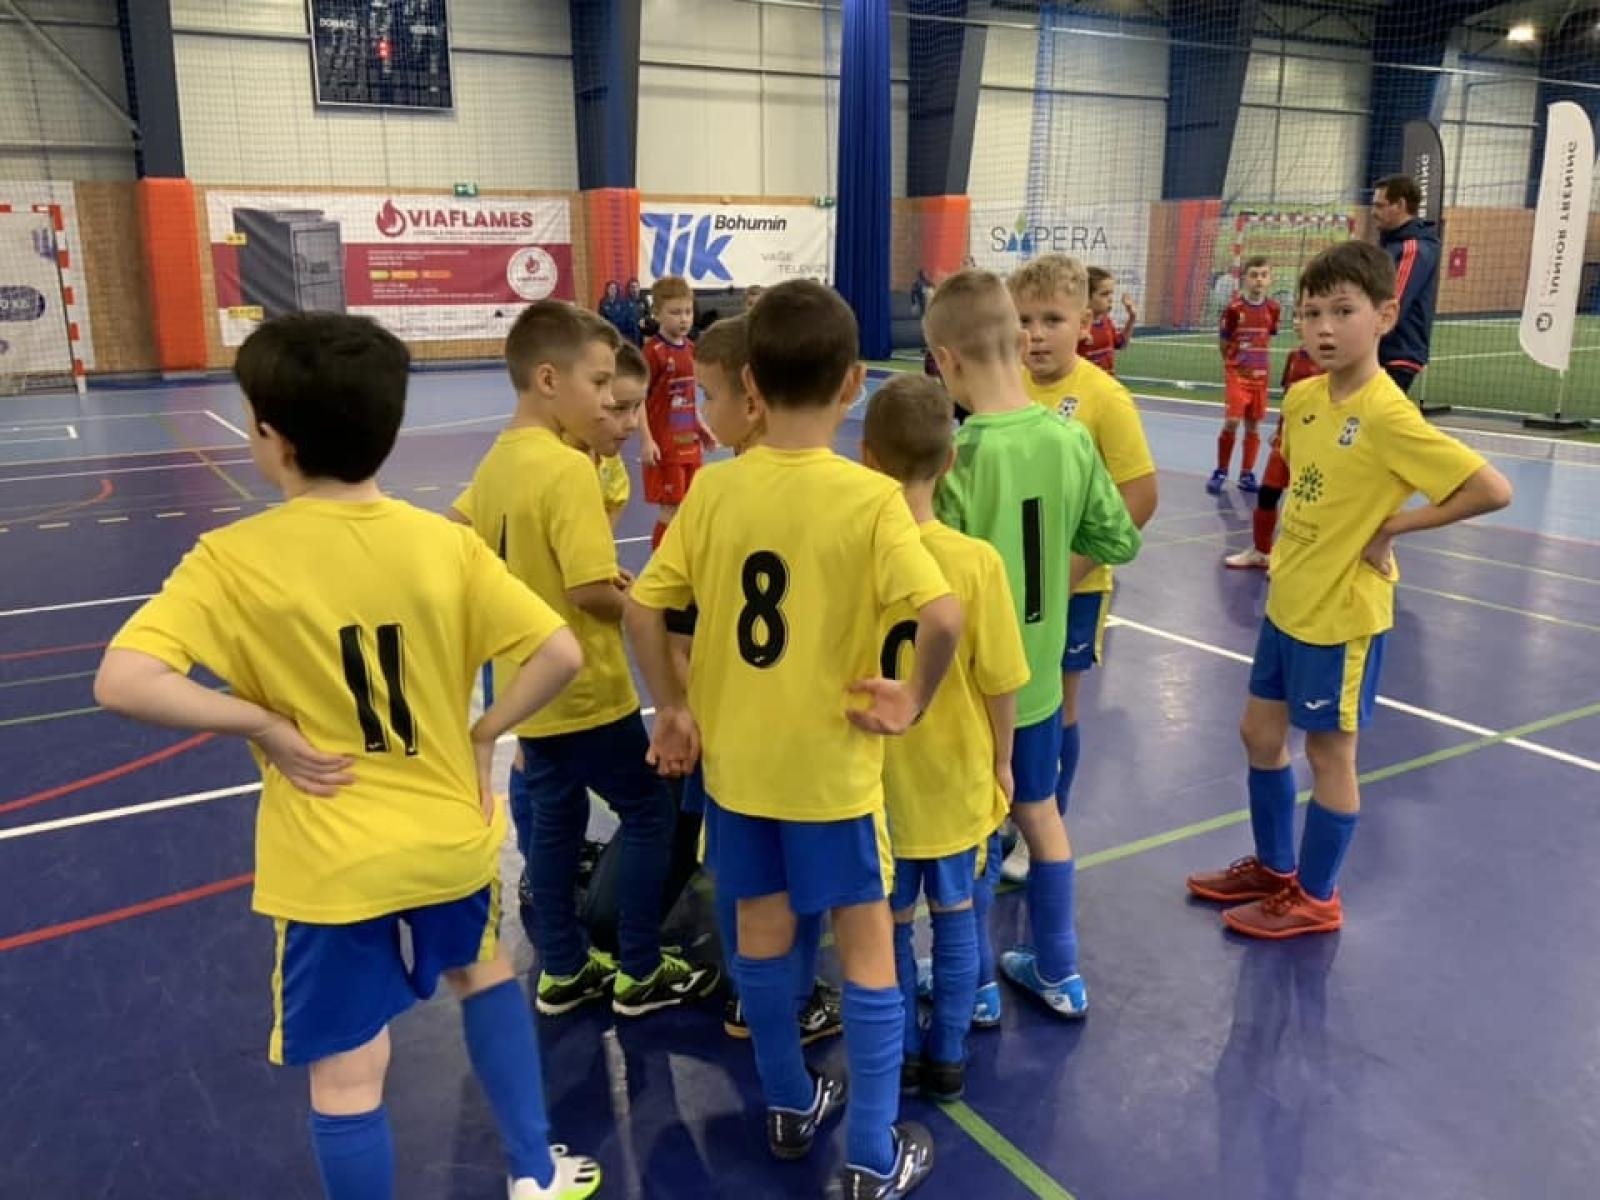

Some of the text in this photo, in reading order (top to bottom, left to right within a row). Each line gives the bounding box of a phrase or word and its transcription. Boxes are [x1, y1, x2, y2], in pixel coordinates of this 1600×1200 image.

[408, 209, 534, 228] VIAFLAMES
[737, 549, 790, 669] 8
[1022, 497, 1045, 624] 1
[338, 622, 419, 757] 11
